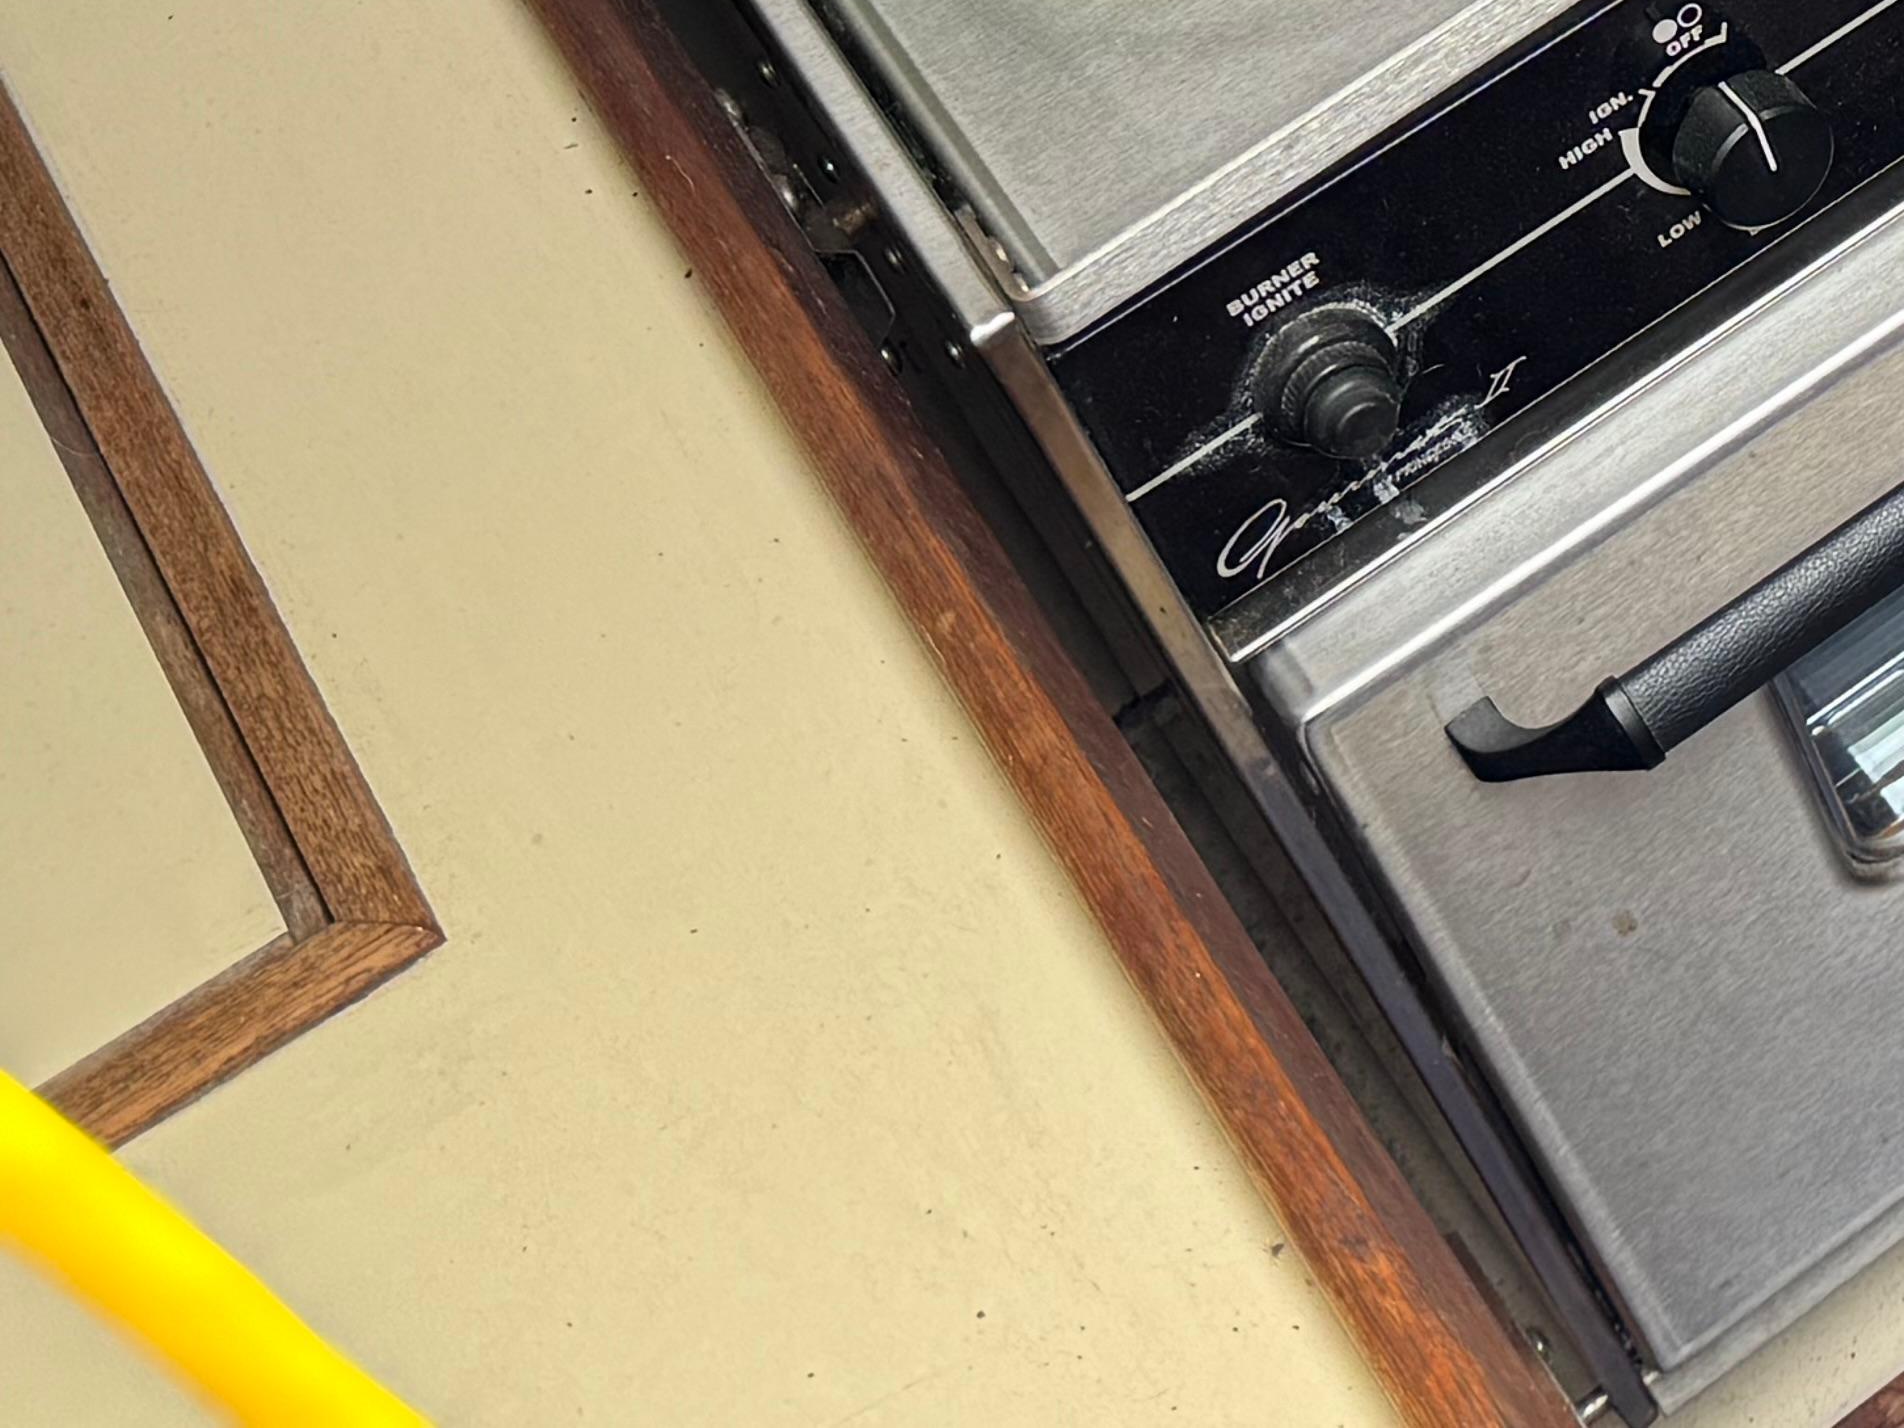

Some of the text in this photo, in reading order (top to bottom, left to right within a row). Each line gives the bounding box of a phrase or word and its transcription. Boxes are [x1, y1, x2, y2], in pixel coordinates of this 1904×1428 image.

[1665, 25, 1704, 57] OFF
[1588, 92, 1634, 125] IGN.
[1558, 126, 1614, 171] HIGH
[1656, 211, 1702, 248] LOW
[1225, 251, 1321, 319] BURNER
[1242, 273, 1320, 328] IGNITE
